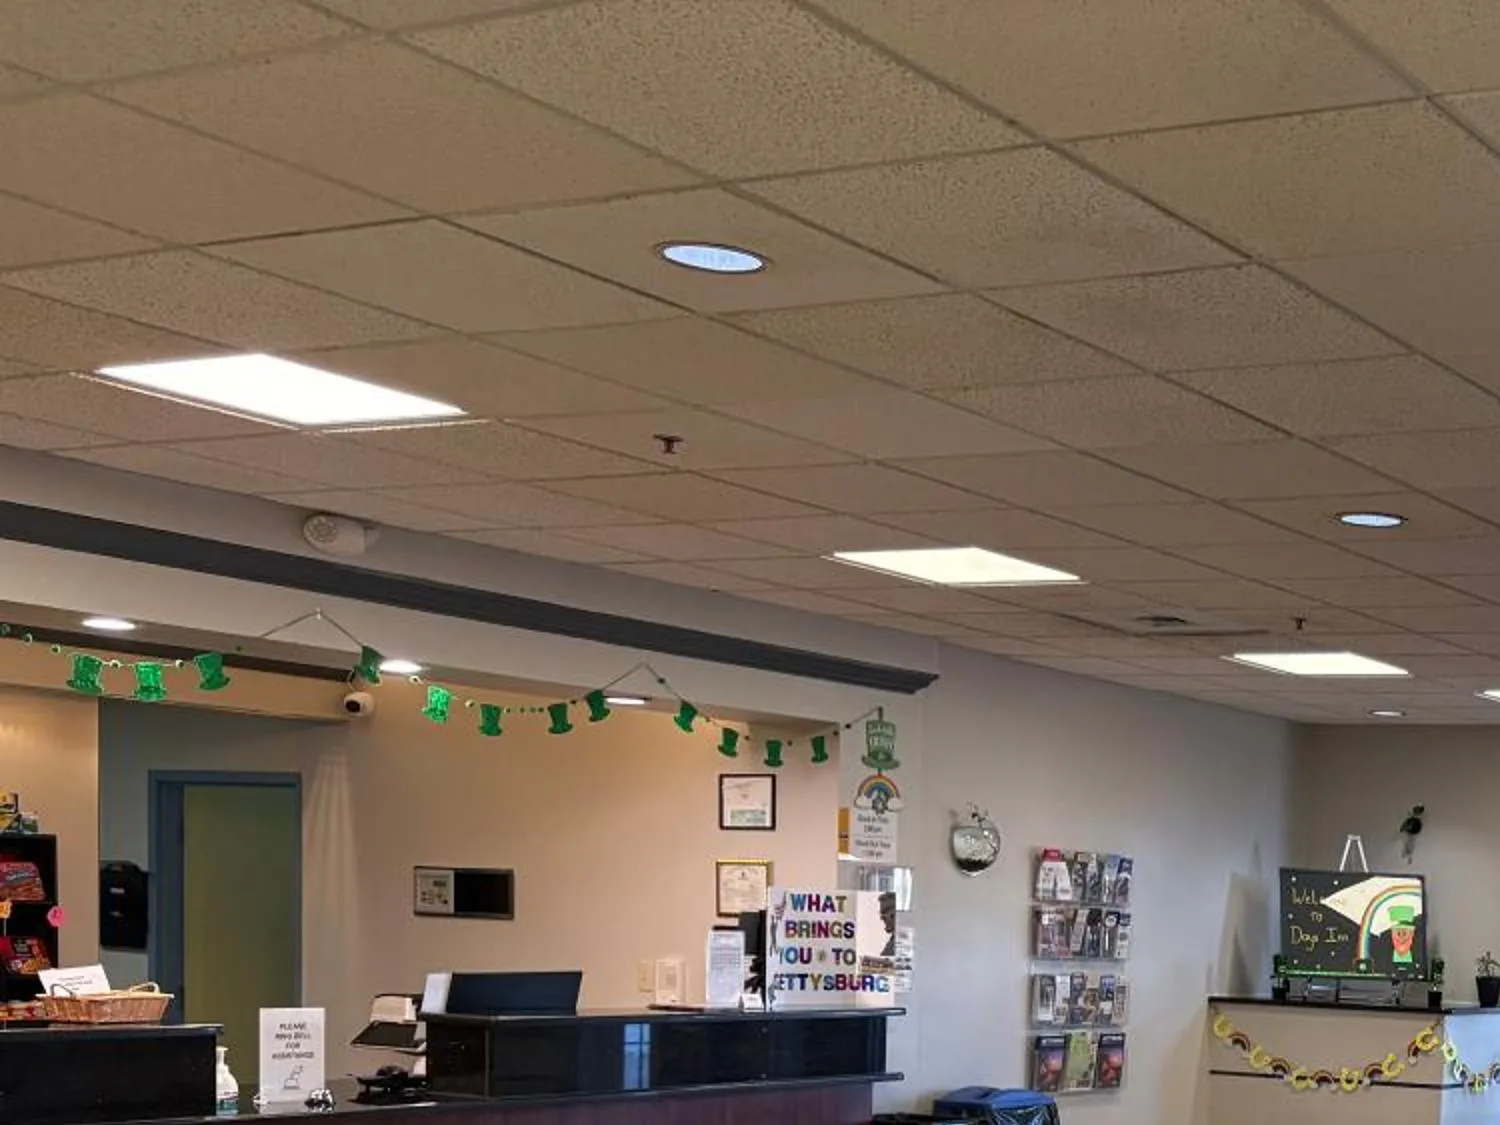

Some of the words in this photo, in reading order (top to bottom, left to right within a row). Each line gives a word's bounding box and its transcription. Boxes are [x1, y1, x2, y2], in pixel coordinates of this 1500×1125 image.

[790, 893, 847, 913] WHAT
[784, 920, 855, 938] BRINGS
[831, 947, 857, 965] TO
